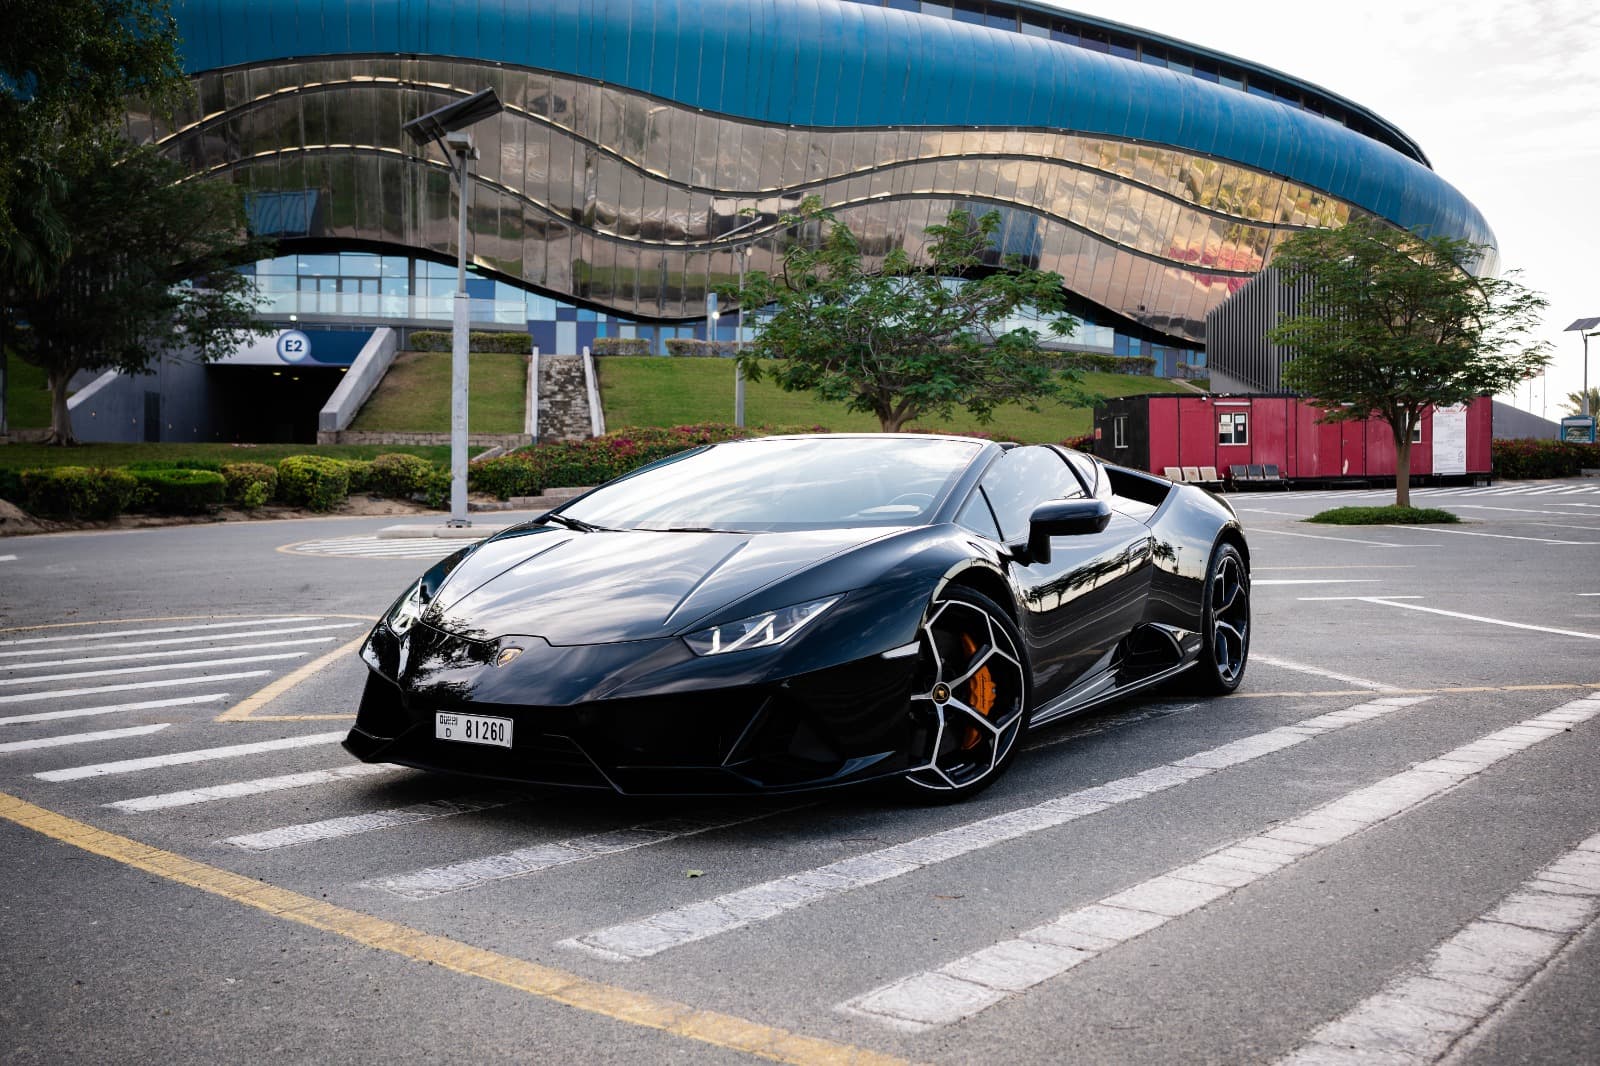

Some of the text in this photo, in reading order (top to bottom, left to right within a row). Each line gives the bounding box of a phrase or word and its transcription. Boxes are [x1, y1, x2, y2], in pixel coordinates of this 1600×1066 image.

[285, 339, 303, 352] E2
[445, 727, 452, 738] D
[465, 719, 504, 742] 81260
